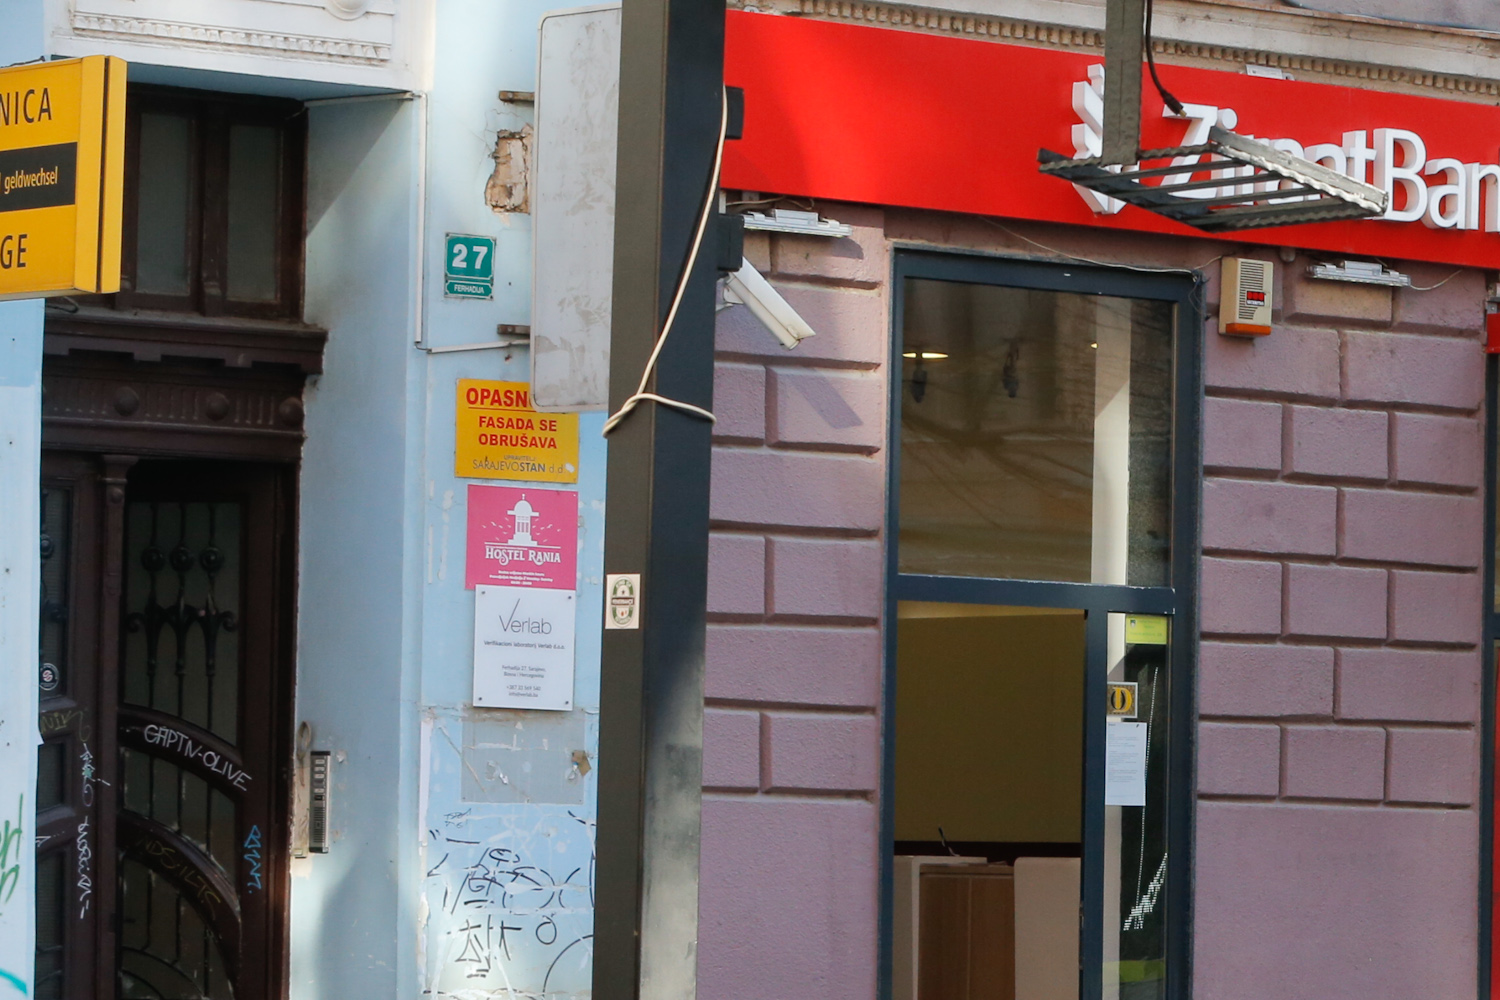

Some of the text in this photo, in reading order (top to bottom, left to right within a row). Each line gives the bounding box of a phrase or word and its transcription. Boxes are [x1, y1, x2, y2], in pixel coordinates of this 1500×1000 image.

[4, 166, 58, 195] geldwechsel
[452, 243, 488, 269] 27
[466, 387, 532, 408] OPASN
[479, 416, 557, 432] FASADA SE
[478, 433, 557, 449] OBRUŠAVA
[473, 459, 546, 472] SARAJEVOSTAN
[485, 547, 561, 566] HOSTEL RANIA
[498, 598, 552, 635] Verlab
